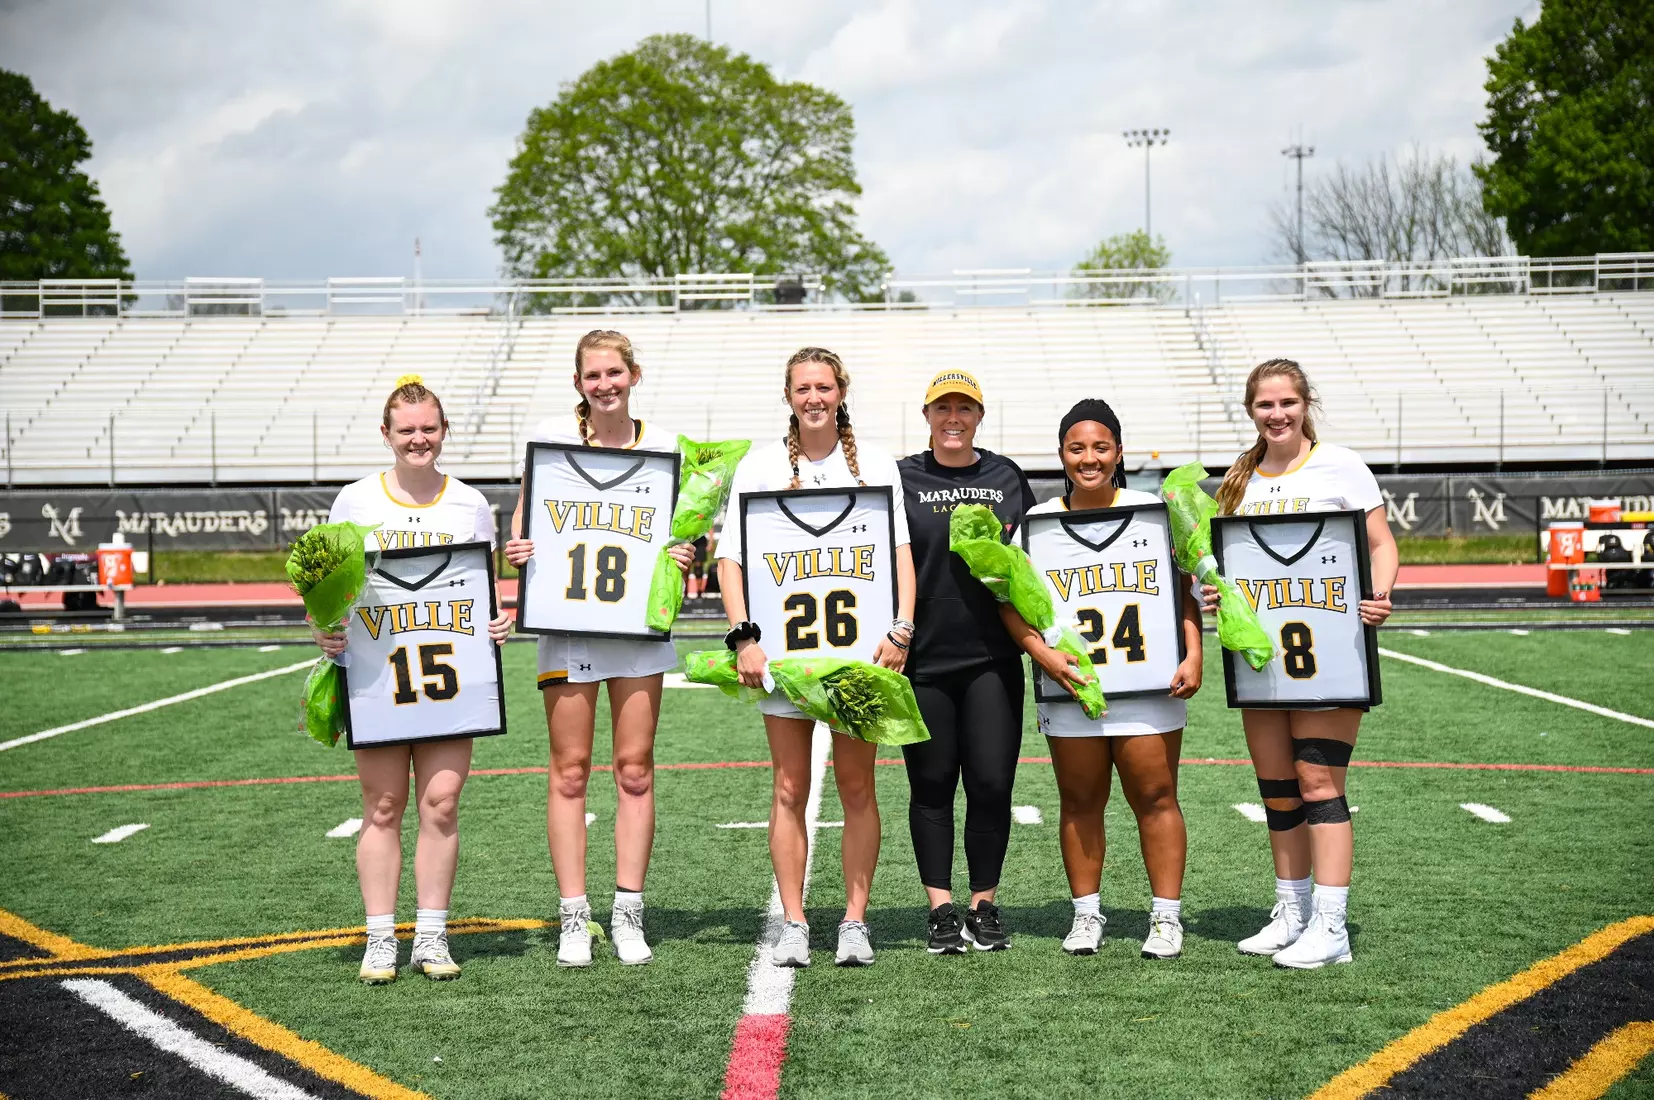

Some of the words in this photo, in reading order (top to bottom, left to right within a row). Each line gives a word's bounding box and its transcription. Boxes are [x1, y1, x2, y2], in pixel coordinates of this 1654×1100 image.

[918, 488, 1003, 503] MARAUDERS
[115, 509, 268, 537] MARAUDERS
[543, 499, 656, 543] VILLE
[564, 541, 628, 604] 18
[763, 544, 875, 586] VILLE
[1046, 559, 1159, 602] VILLE
[1235, 576, 1347, 614] VILLE
[355, 598, 475, 640] VILLE
[783, 588, 859, 652] 26
[1072, 602, 1147, 666] 24
[1280, 620, 1318, 680] 8
[387, 641, 461, 706] 15
